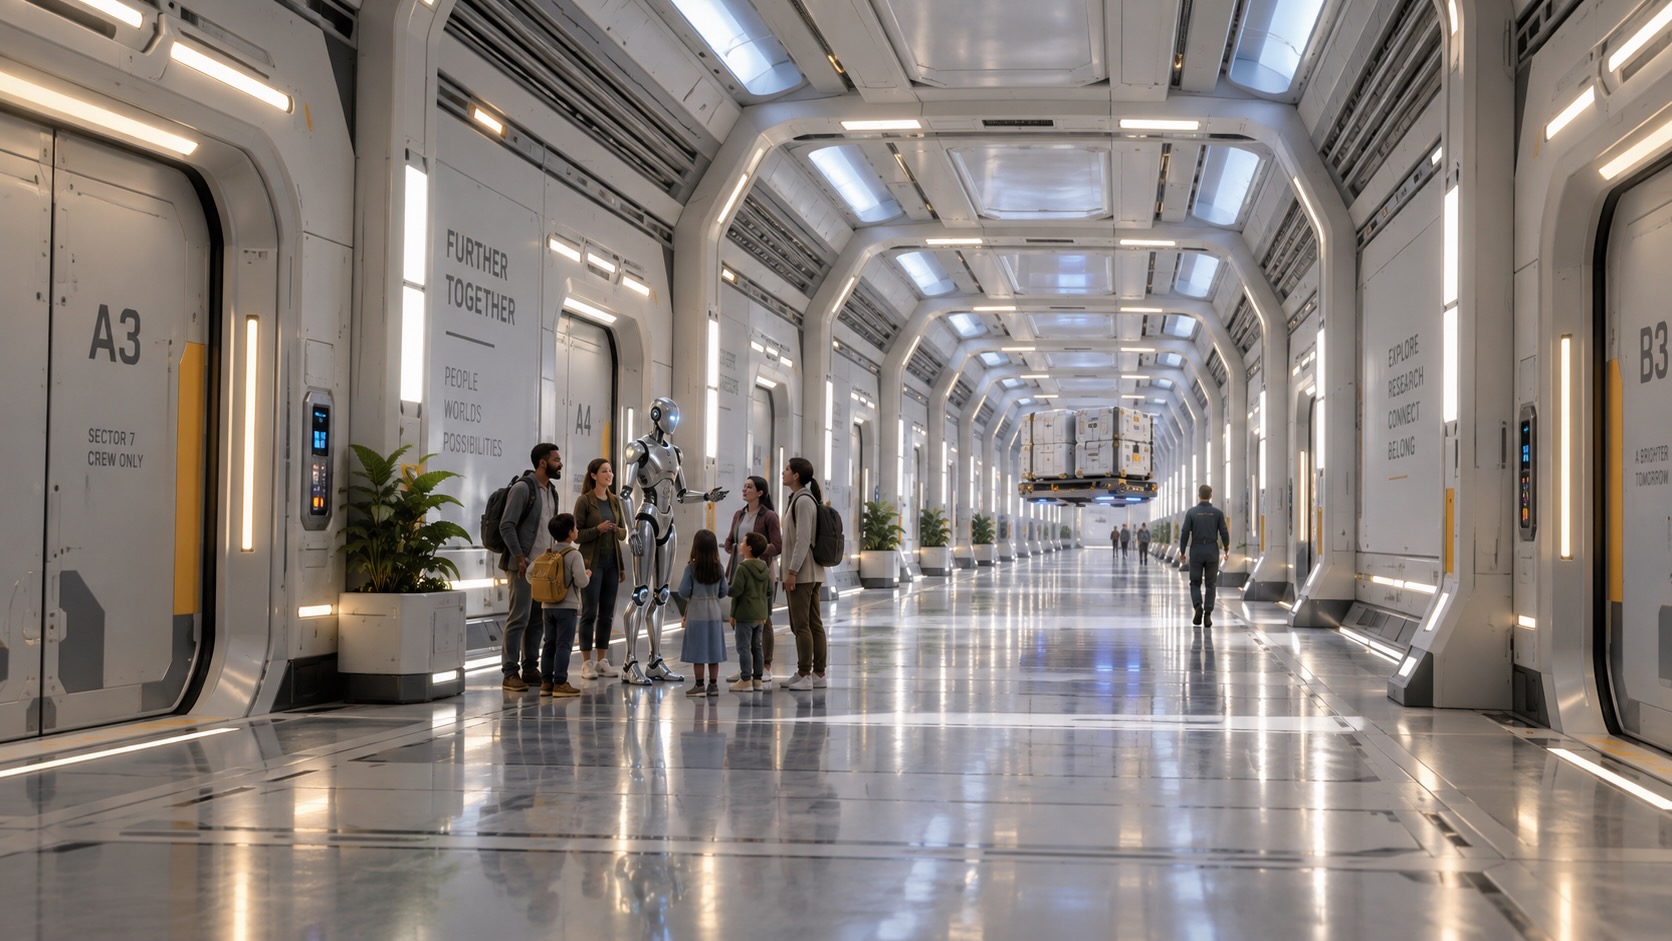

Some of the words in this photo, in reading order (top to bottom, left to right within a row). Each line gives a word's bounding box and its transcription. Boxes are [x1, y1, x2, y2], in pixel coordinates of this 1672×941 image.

[446, 228, 508, 281] FURTHER
[445, 274, 516, 326] TOGETHER
[88, 304, 141, 365] A3
[1388, 334, 1419, 367] EXPLORE
[1640, 320, 1668, 384] B3
[444, 366, 478, 391] PEOPLE
[1388, 366, 1424, 399] RESEARCH
[444, 399, 481, 423] WORLDS
[575, 403, 591, 436] A4
[1388, 401, 1420, 430] CONNECT
[88, 428, 126, 445] SECTOR
[129, 432, 135, 446] 7
[443, 432, 503, 457] POSSIBILITIES
[1388, 436, 1415, 460] BELONG
[87, 451, 116, 467] CREW
[119, 454, 143, 468] ONLY
